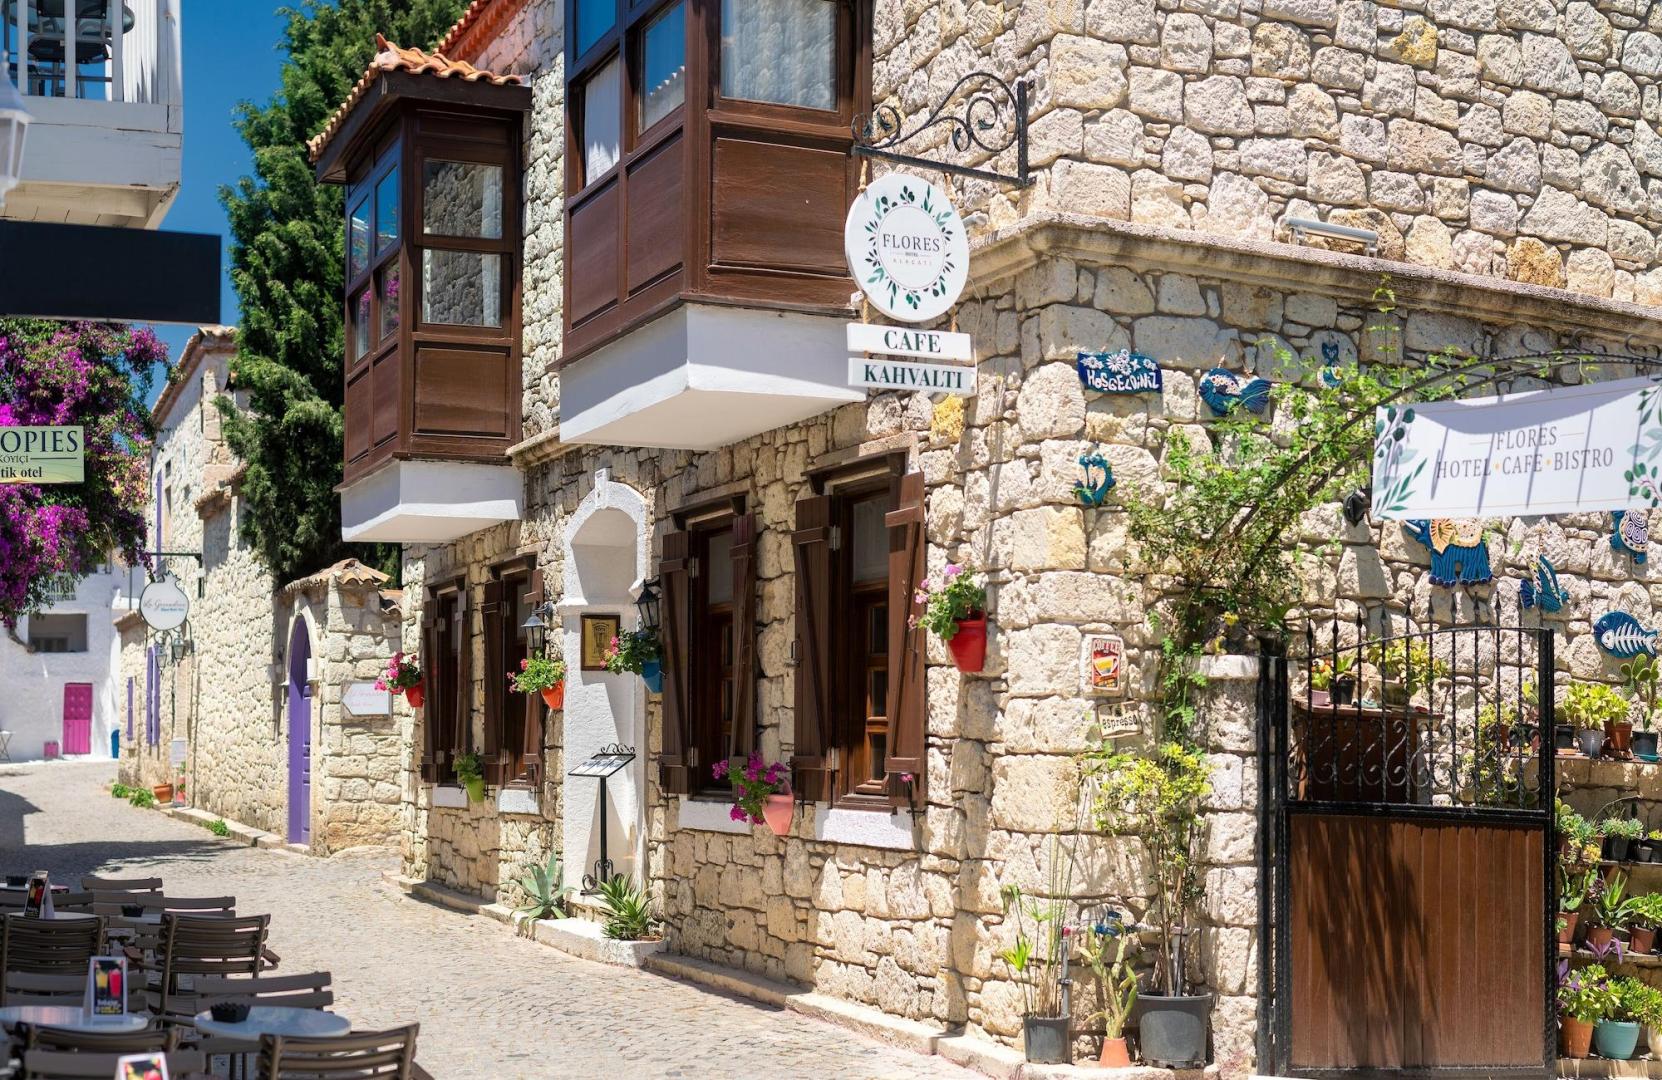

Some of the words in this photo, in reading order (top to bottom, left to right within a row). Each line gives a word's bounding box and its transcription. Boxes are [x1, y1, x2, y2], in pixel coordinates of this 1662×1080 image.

[882, 233, 940, 252] FLORES
[884, 329, 942, 354] CAFE
[864, 364, 963, 389] KAHVALTI
[0, 430, 78, 453] OPIES
[1496, 425, 1558, 450] FLORES
[20, 466, 42, 478] otel
[1437, 457, 1491, 480] HOTEL
[1502, 453, 1543, 476] CAFE
[1553, 447, 1614, 471] BISTRO
[1093, 638, 1121, 653] COFFEE
[1102, 713, 1138, 730] espresso
